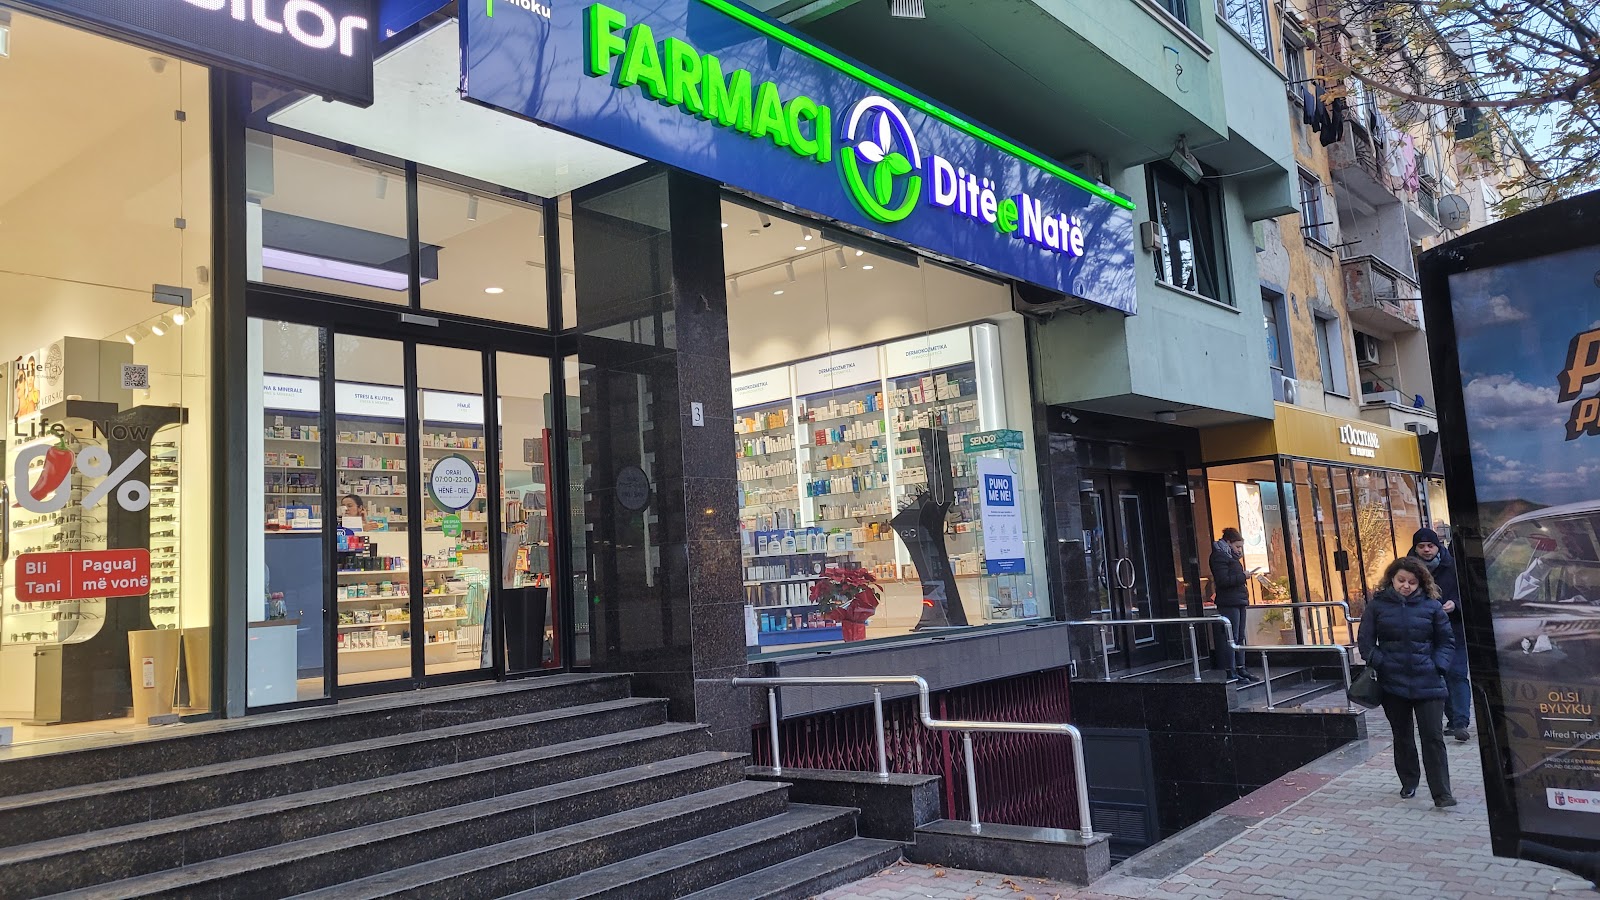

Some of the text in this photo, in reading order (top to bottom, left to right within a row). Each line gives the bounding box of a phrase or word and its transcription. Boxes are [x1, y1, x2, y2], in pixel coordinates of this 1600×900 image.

[588, 2, 832, 163] FARMACI
[928, 154, 1085, 257] Ditë e Natë
[905, 344, 948, 357] DERMOKOZMETIKA
[818, 362, 856, 375] DERMOKOZMETIKA
[734, 381, 769, 393] DERMOKOZMETIKA
[694, 406, 701, 422] 3
[14, 417, 65, 439] Life
[93, 420, 150, 442] Now
[969, 434, 997, 447] SENDO
[988, 477, 1009, 490] PUNO
[988, 490, 1012, 502] ME NE!
[25, 561, 47, 575] Bli
[82, 557, 137, 574] Paguaj
[25, 579, 61, 594] Tani
[82, 574, 149, 591] më vonë
[1548, 691, 1579, 703] OLSI
[1539, 703, 1592, 715] BYLYKU
[1543, 730, 1570, 739] Alfred
